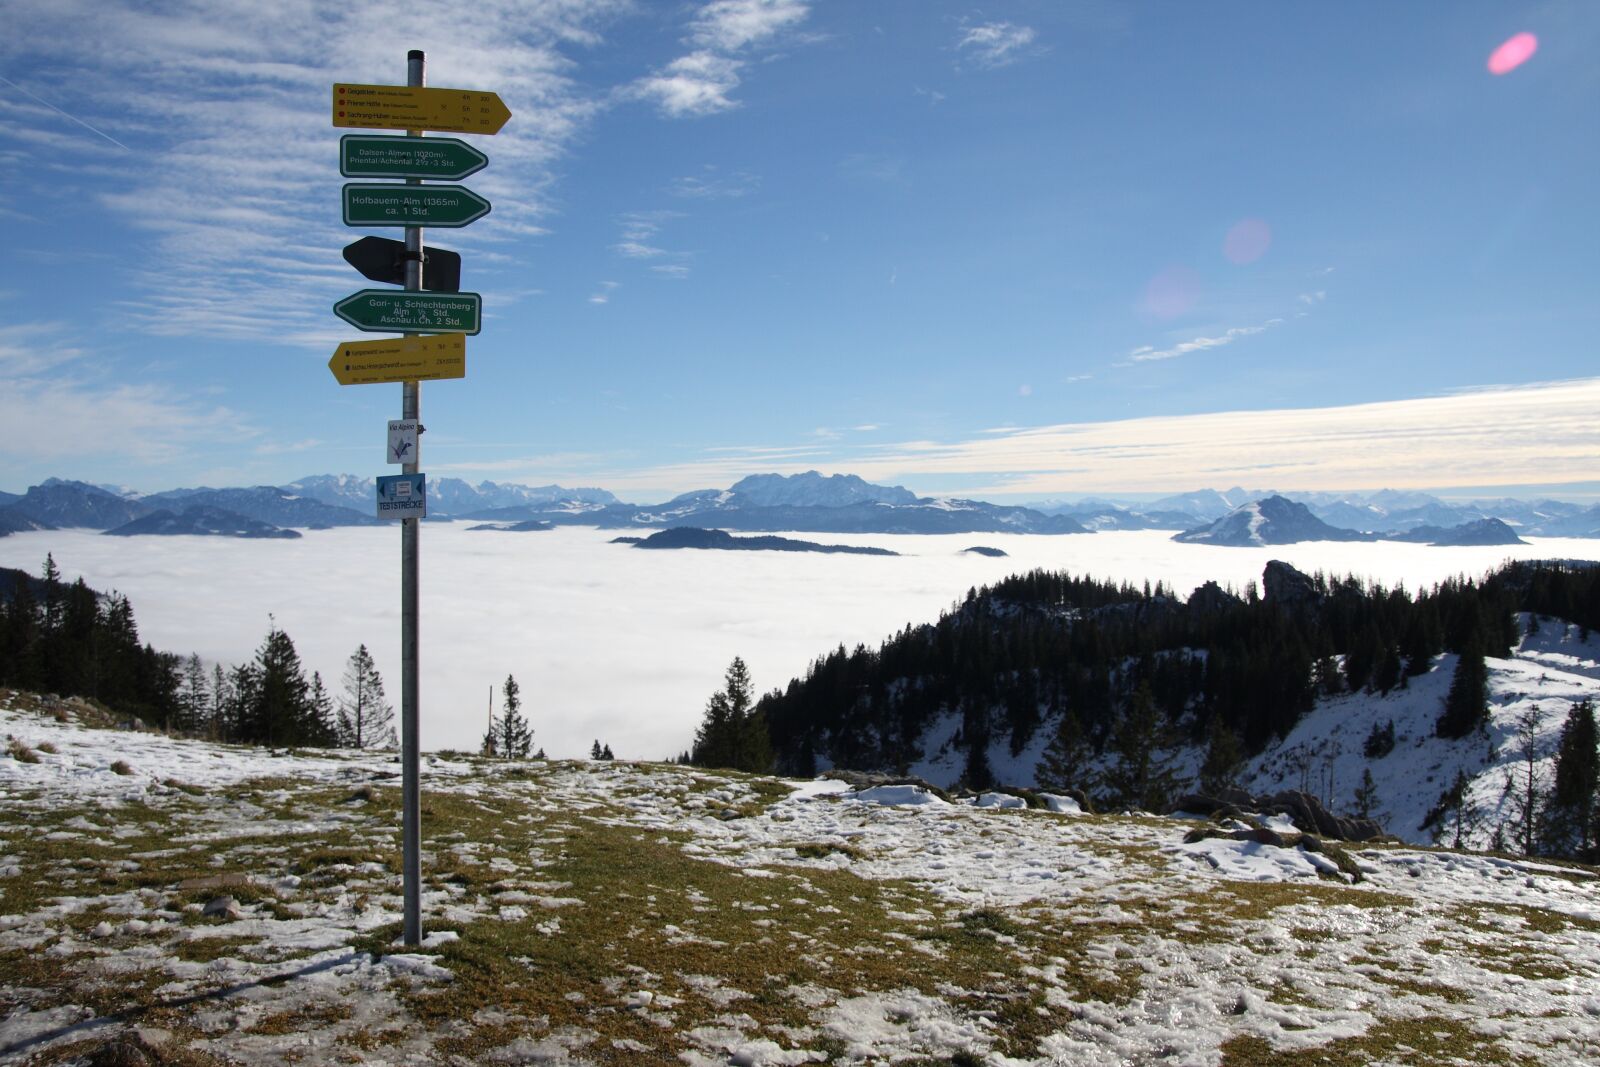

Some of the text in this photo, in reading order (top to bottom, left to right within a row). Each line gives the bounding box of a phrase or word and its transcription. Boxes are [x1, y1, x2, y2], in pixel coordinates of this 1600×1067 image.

[352, 196, 459, 206] Hofbauern-Alm (1365m)
[412, 208, 430, 216] Std.
[404, 300, 475, 312] Schlechtenberg-
[393, 308, 410, 316] Alm
[433, 308, 450, 316] Std.
[380, 316, 412, 324] Aschau
[445, 318, 462, 326] Std.
[379, 500, 424, 510] TESTSTRECKE
